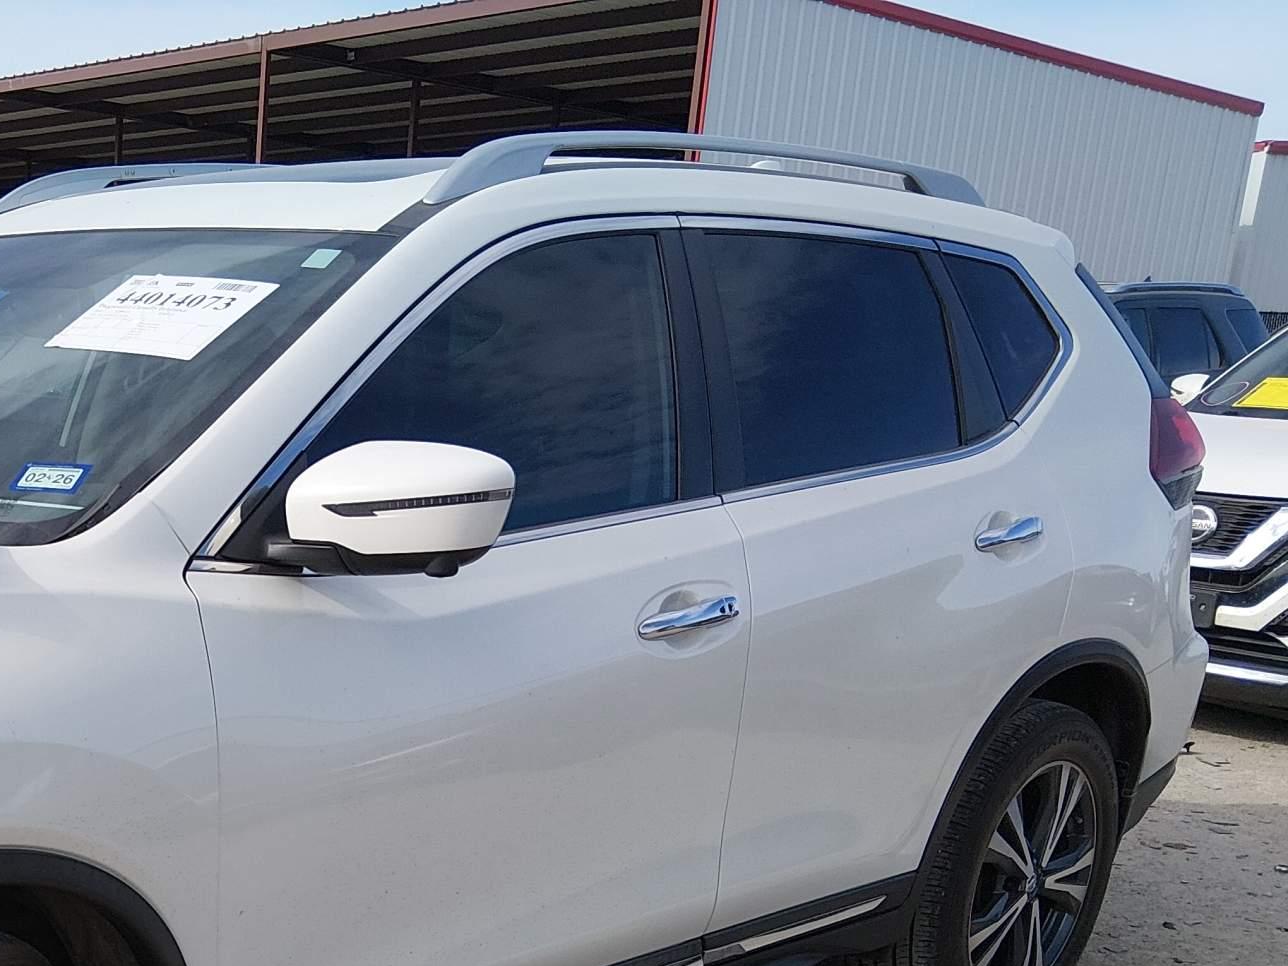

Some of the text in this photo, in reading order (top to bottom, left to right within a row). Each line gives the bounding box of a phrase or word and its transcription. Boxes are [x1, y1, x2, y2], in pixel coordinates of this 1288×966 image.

[116, 291, 238, 311] 44014073
[24, 472, 76, 485] 02 26
